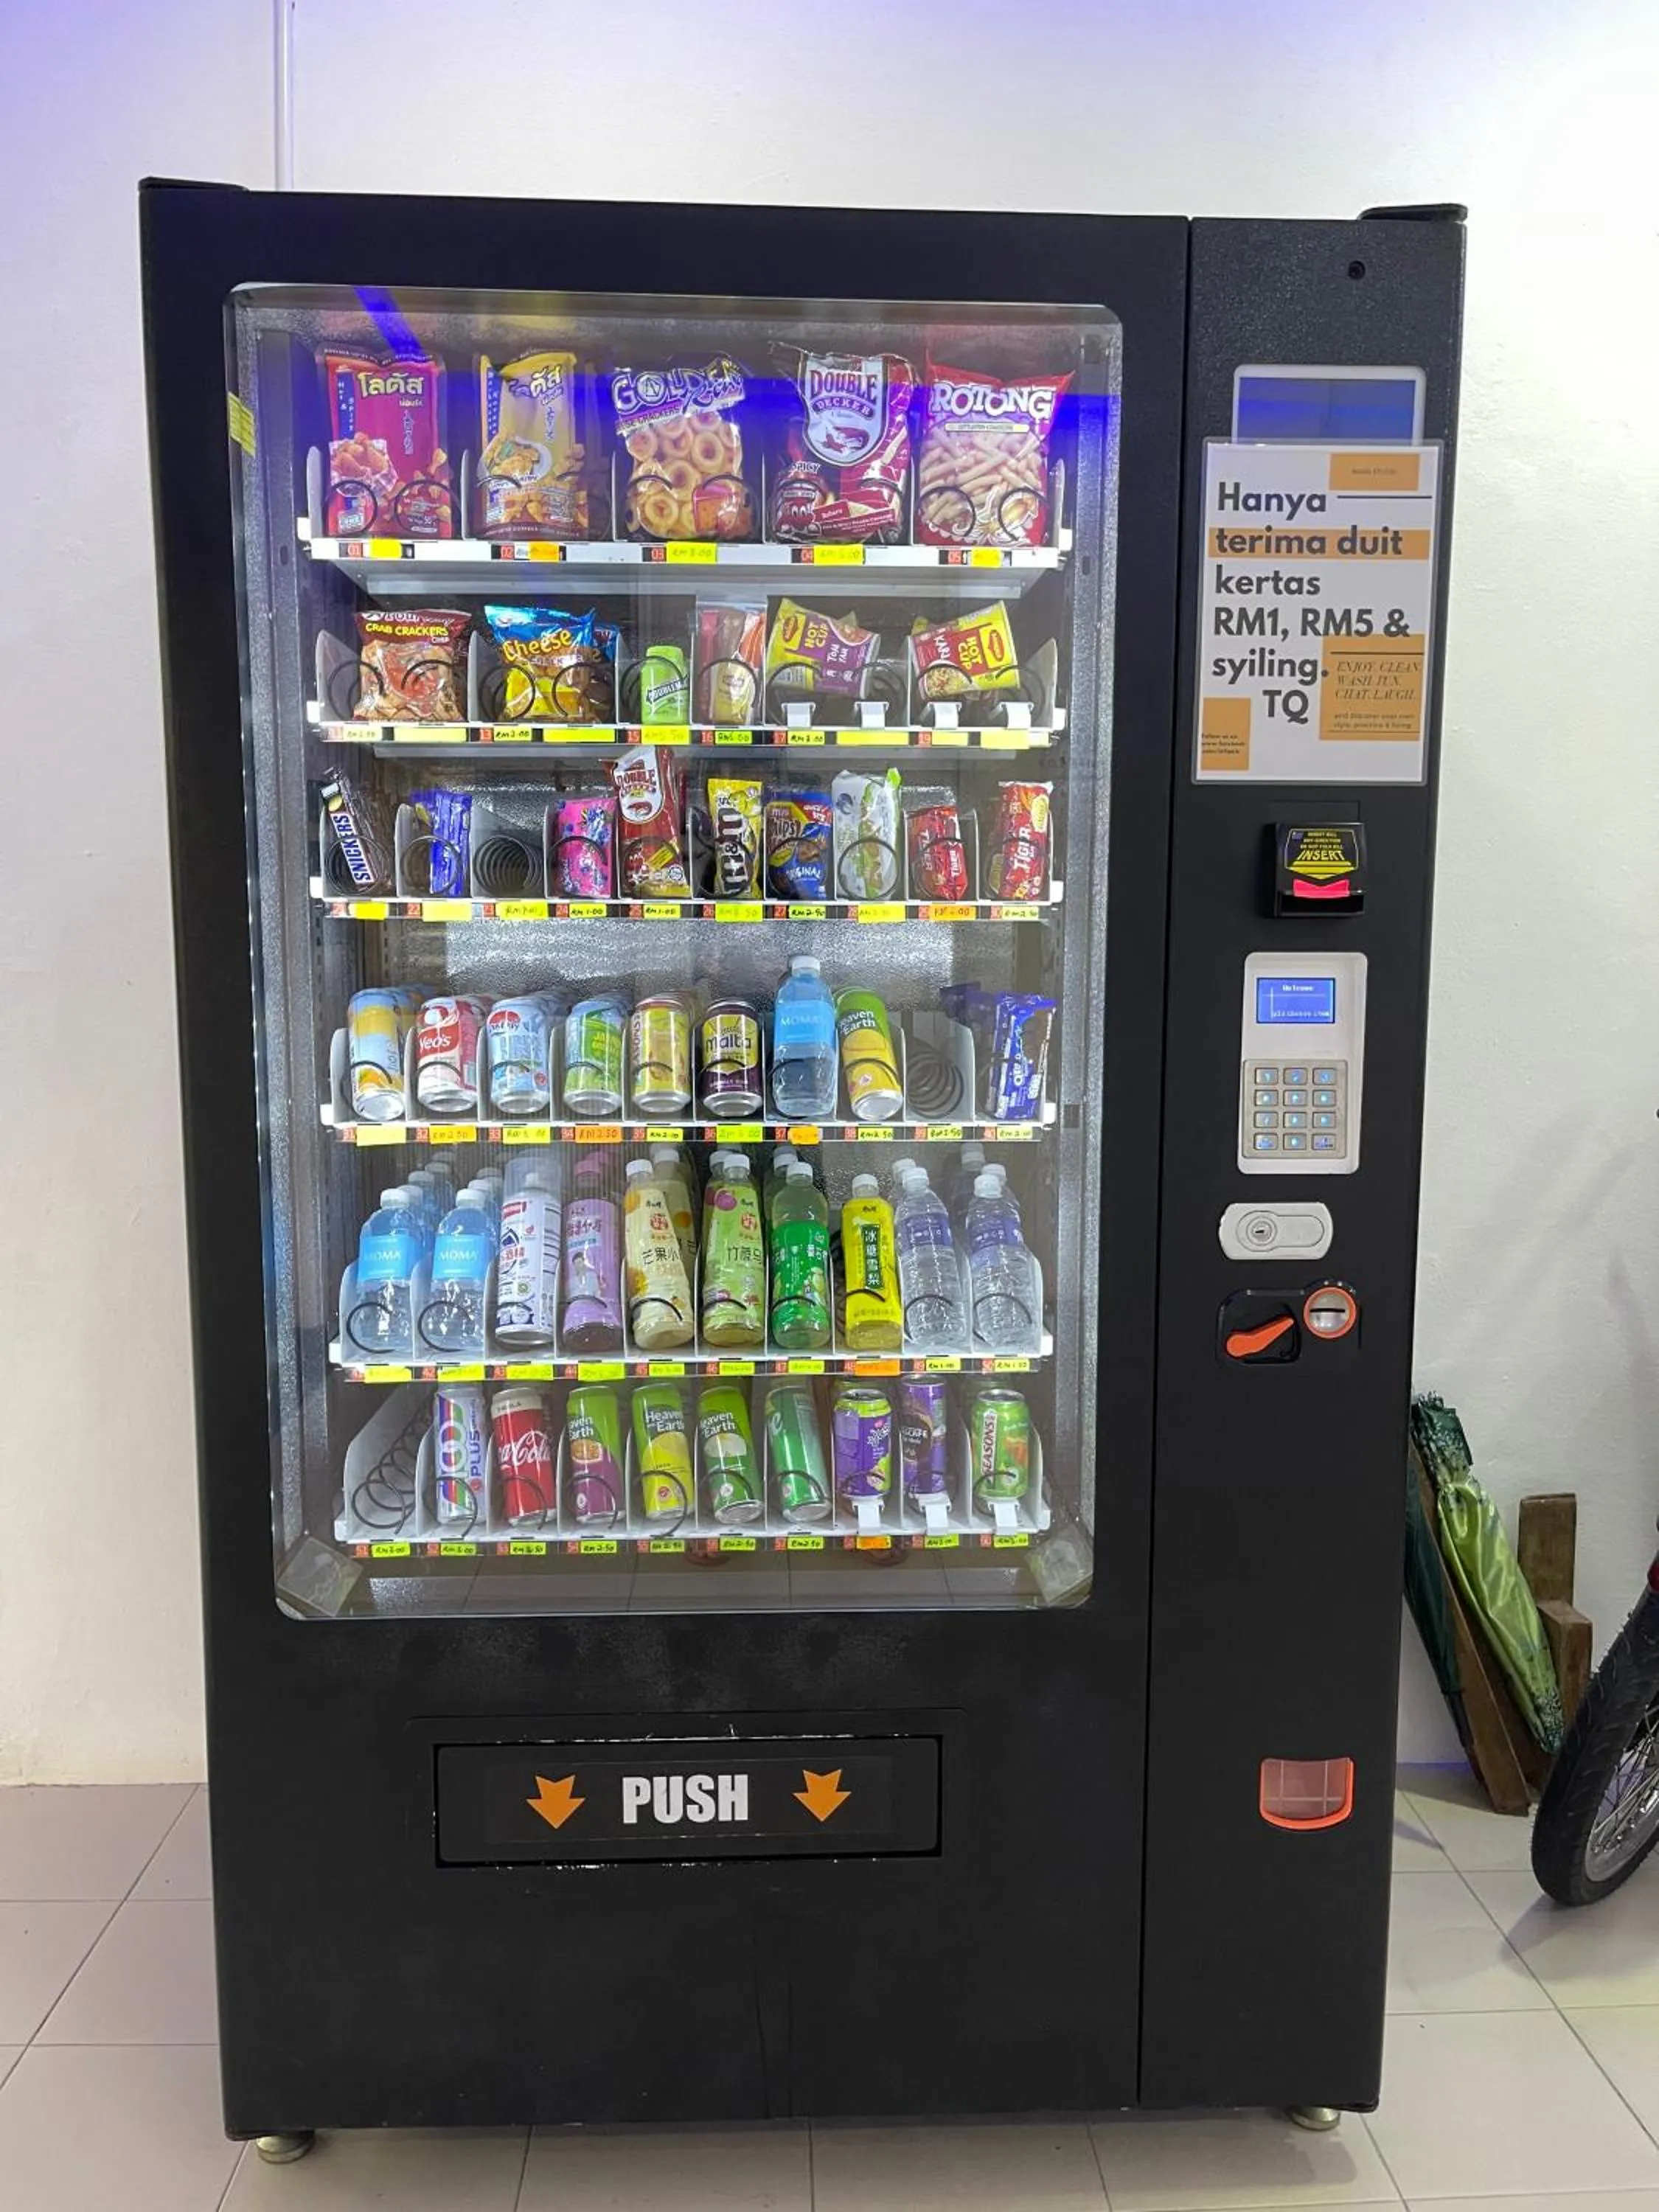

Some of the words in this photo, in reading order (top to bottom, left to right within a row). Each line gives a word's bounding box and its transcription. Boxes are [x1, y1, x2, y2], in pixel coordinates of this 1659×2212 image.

[812, 370, 878, 403] DOUBLE
[931, 381, 1055, 418] ROTONG
[815, 398, 873, 417] DECKER
[1218, 482, 1326, 520] Hanya
[1217, 526, 1326, 555] terima
[1337, 524, 1403, 555] duit
[1216, 565, 1321, 595] kertas
[365, 623, 393, 634] CRAB
[394, 626, 449, 637] CRACKERS
[1214, 607, 1289, 641] RM1,
[1301, 608, 1374, 637] RM5
[1383, 609, 1411, 637] &
[503, 628, 573, 661] Cheese
[958, 642, 973, 670] CUP
[966, 636, 984, 664] HOT
[1211, 647, 1329, 686] syiling.
[1262, 689, 1310, 725] TQ
[333, 814, 372, 883] SNICKERS
[1296, 850, 1345, 861] INSERT
[469, 1430, 482, 1478] PLUS
[622, 1774, 748, 1824] PUSH
